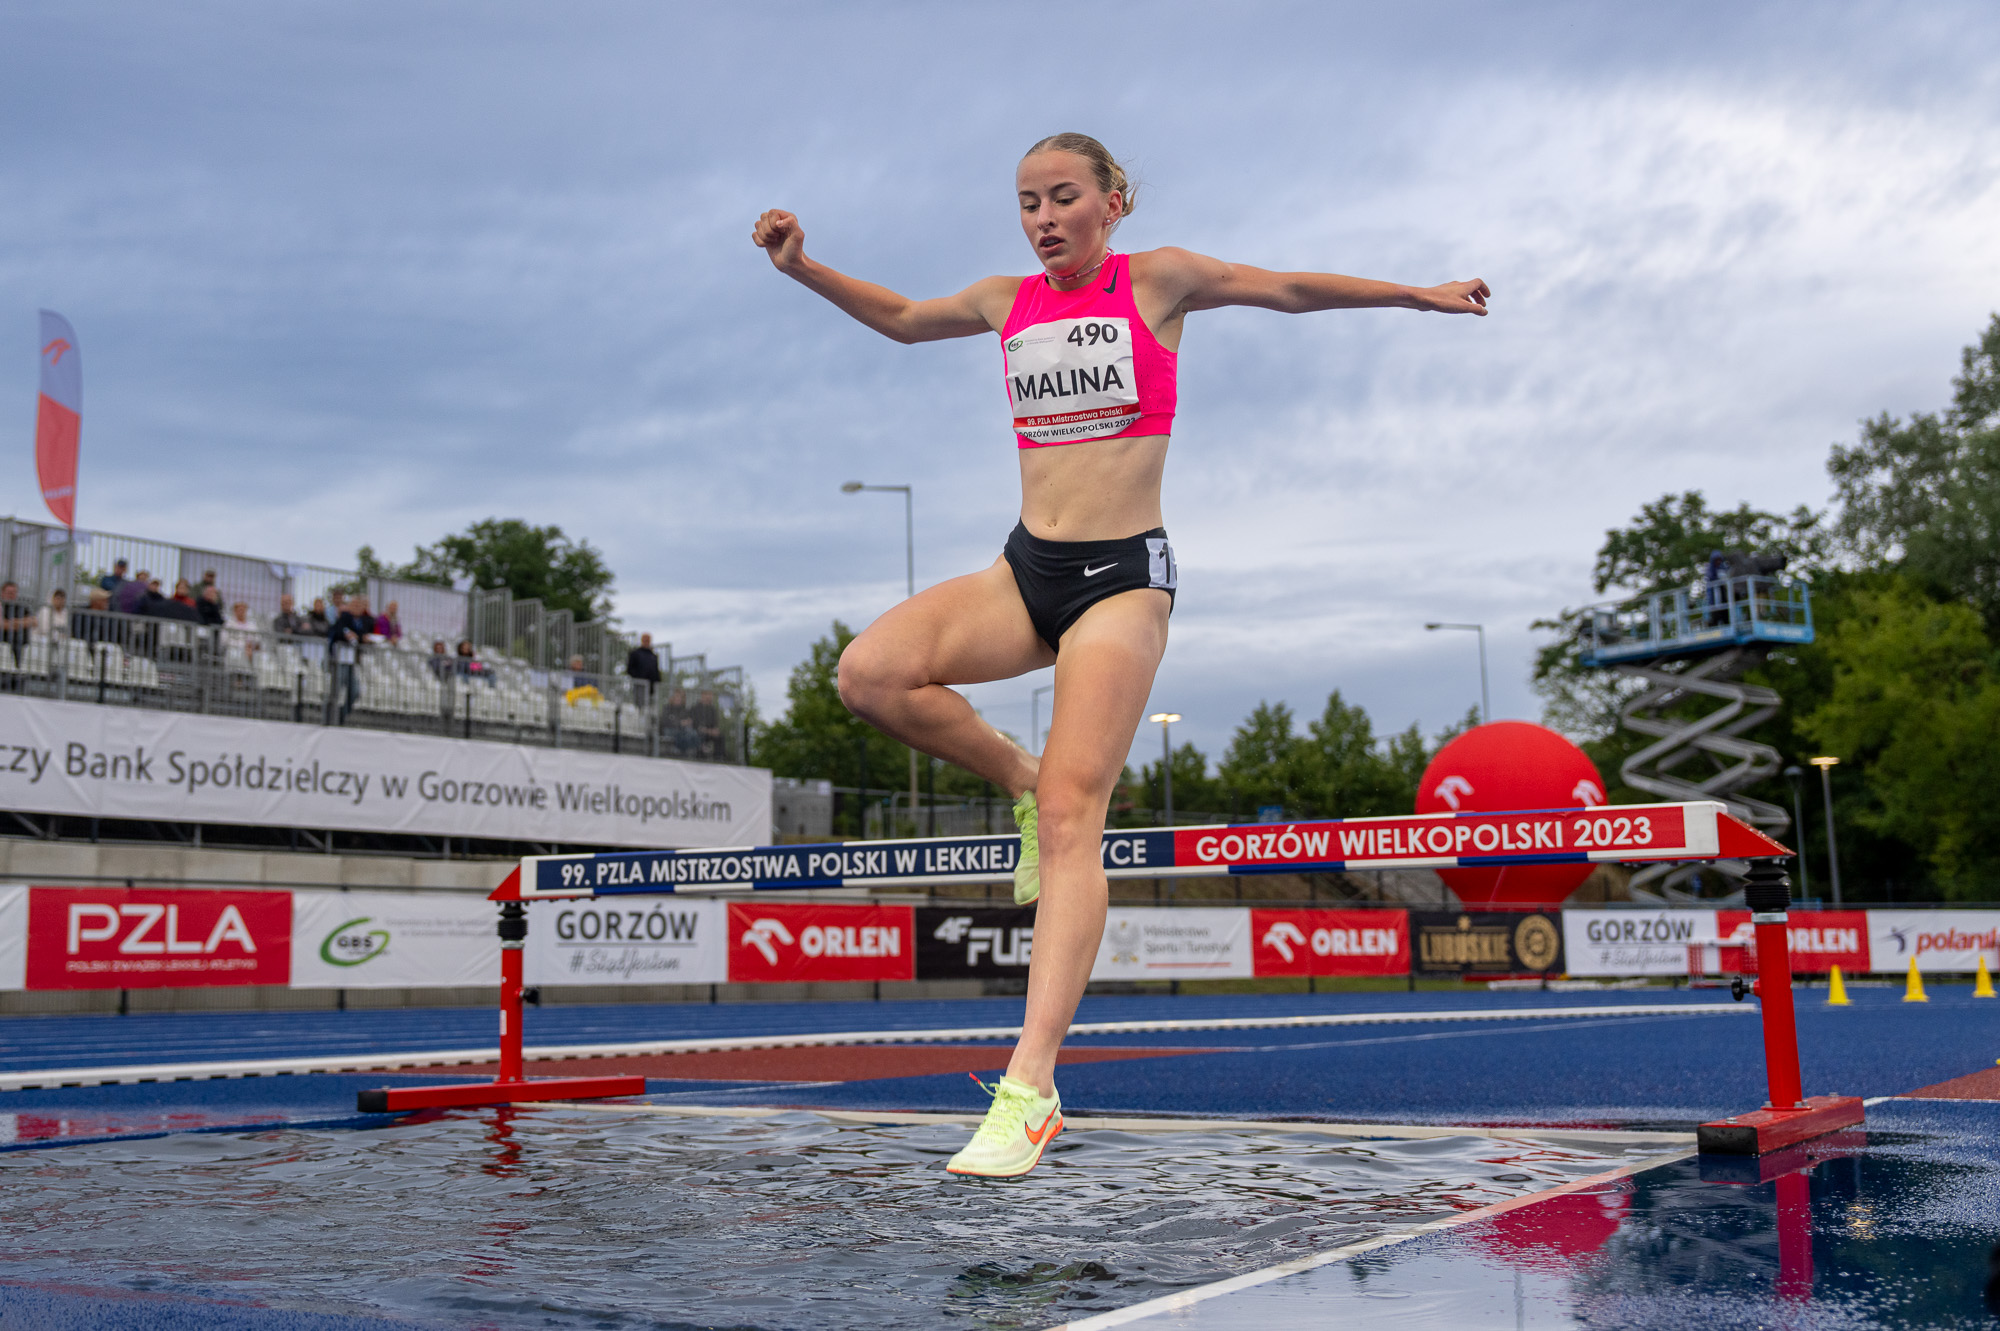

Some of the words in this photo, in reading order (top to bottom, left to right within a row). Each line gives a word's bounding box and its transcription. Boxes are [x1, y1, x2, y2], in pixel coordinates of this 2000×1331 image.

[1067, 322, 1119, 347] 490
[1014, 364, 1125, 402] MALINA
[1037, 416, 1052, 425] PZLA
[1052, 411, 1099, 424] Mistrzostwa
[1099, 407, 1123, 417] Polski
[1050, 421, 1114, 437] WIELKOPOLSKI
[66, 741, 154, 782] Bank
[167, 750, 370, 805] Spółdzielczy
[381, 774, 409, 799] w
[417, 770, 548, 810] Gorzowie
[554, 780, 732, 824] Wielkopolskim
[1195, 824, 1331, 863] GORZÓW
[1338, 820, 1564, 855] WIELKOPOLSKI
[1572, 815, 1654, 848] 2023
[561, 863, 591, 887] 99.
[596, 861, 645, 886] PZLA
[649, 854, 802, 883] MISTRZOSTWA
[808, 848, 888, 877] POLSKI
[894, 848, 918, 873] W
[924, 844, 1015, 872] LEKKIEJ
[66, 903, 258, 955] PZLA
[556, 902, 699, 941] GORZÓW
[933, 916, 973, 944] 4F
[1586, 911, 1695, 942] GORZÓW
[800, 926, 901, 958] ORLEN
[1311, 927, 1399, 957] ORLEN
